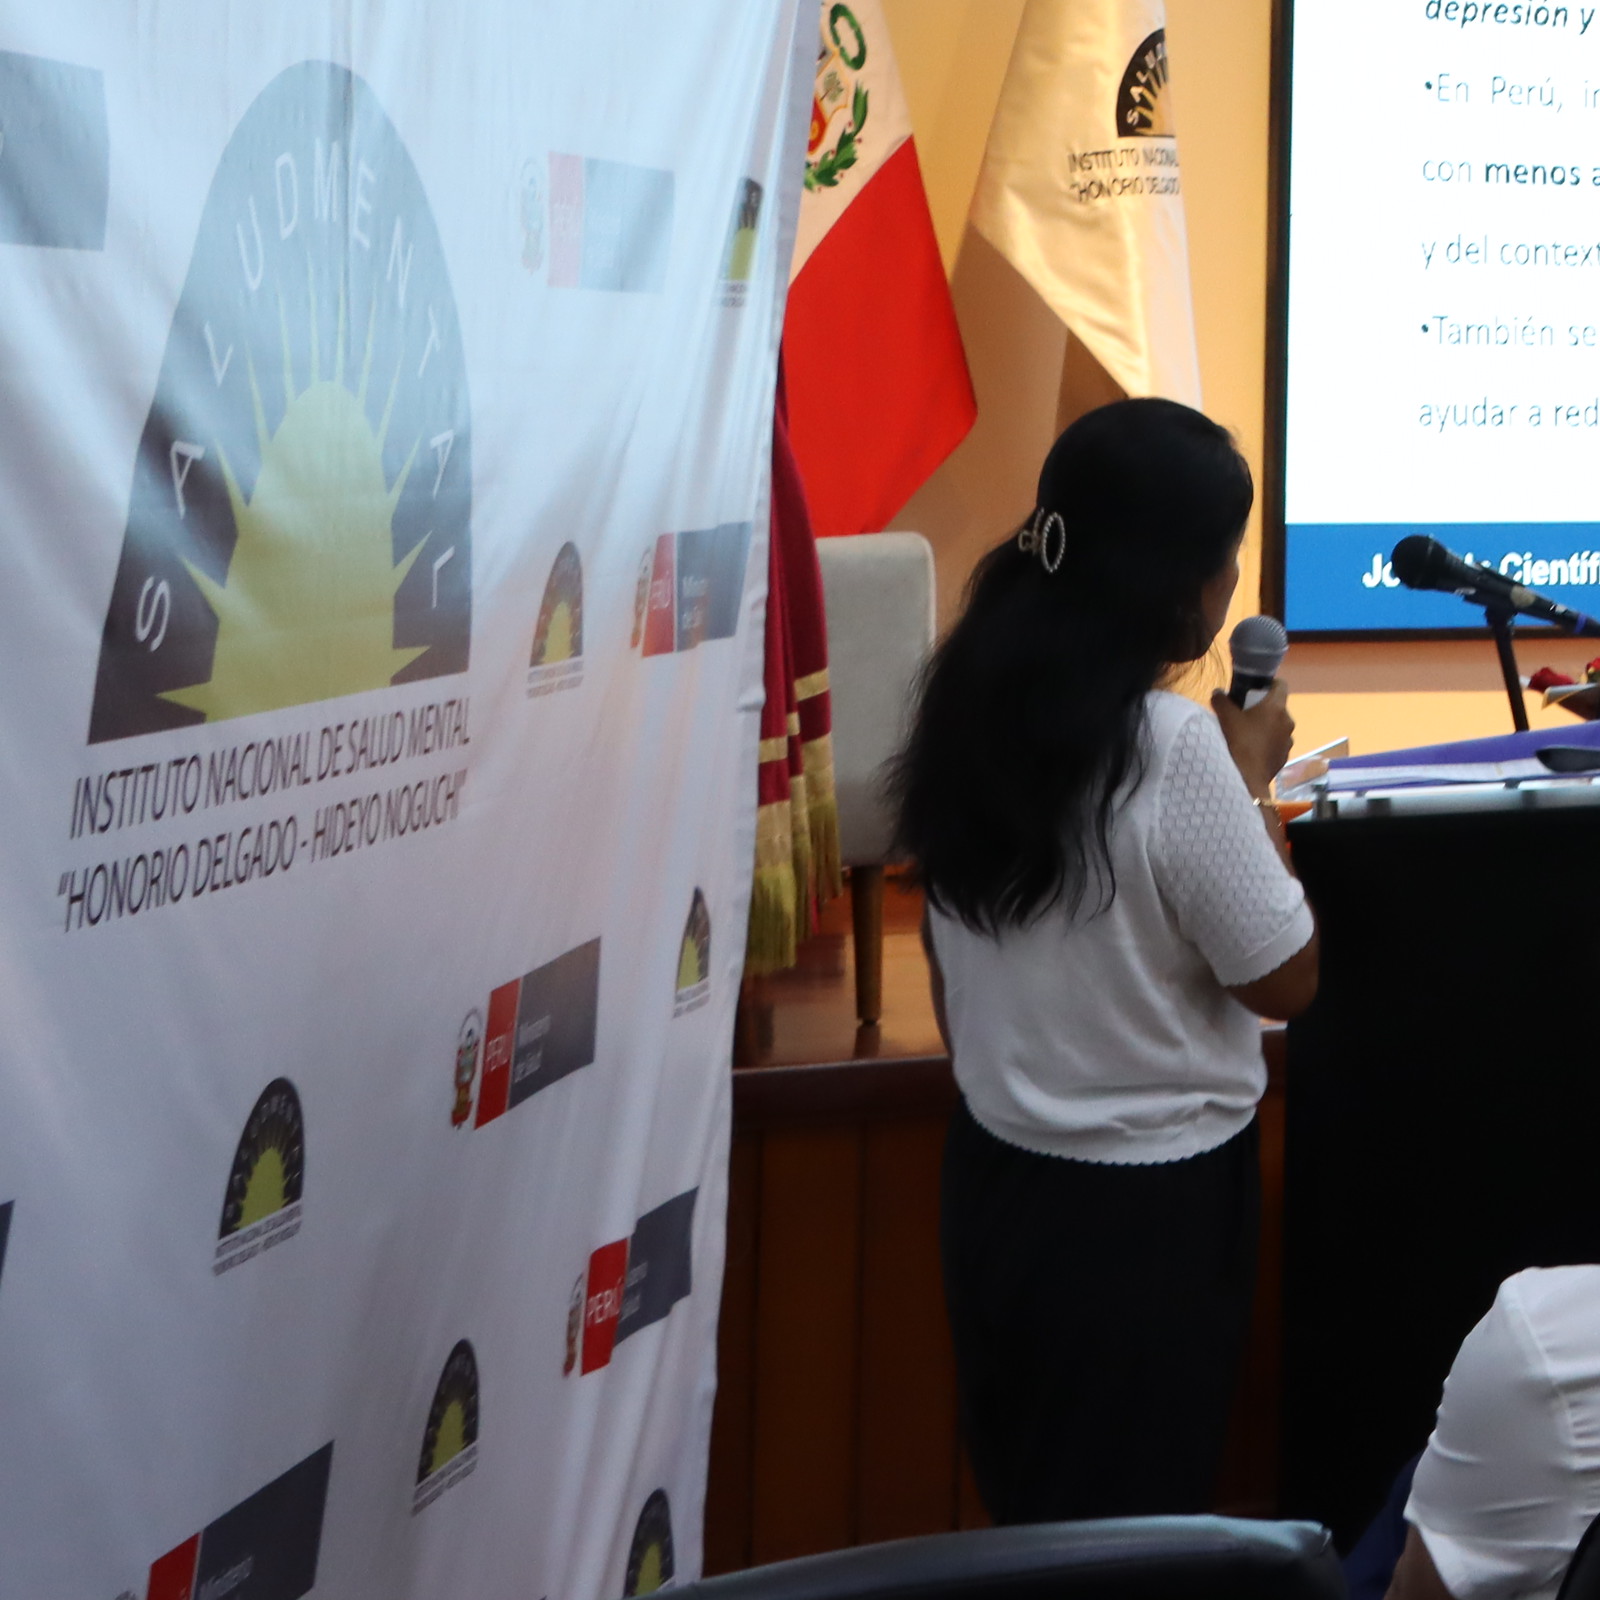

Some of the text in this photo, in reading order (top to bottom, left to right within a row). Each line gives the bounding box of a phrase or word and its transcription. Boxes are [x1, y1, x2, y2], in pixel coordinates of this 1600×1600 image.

[1577, 6, 1597, 37] y
[1483, 160, 1583, 188] menos
[69, 697, 471, 840] INSTITUTO NACIONAL DE SALUD MENTAL
[192, 815, 298, 898] DELGADO
[310, 793, 380, 863] HIDEYO
